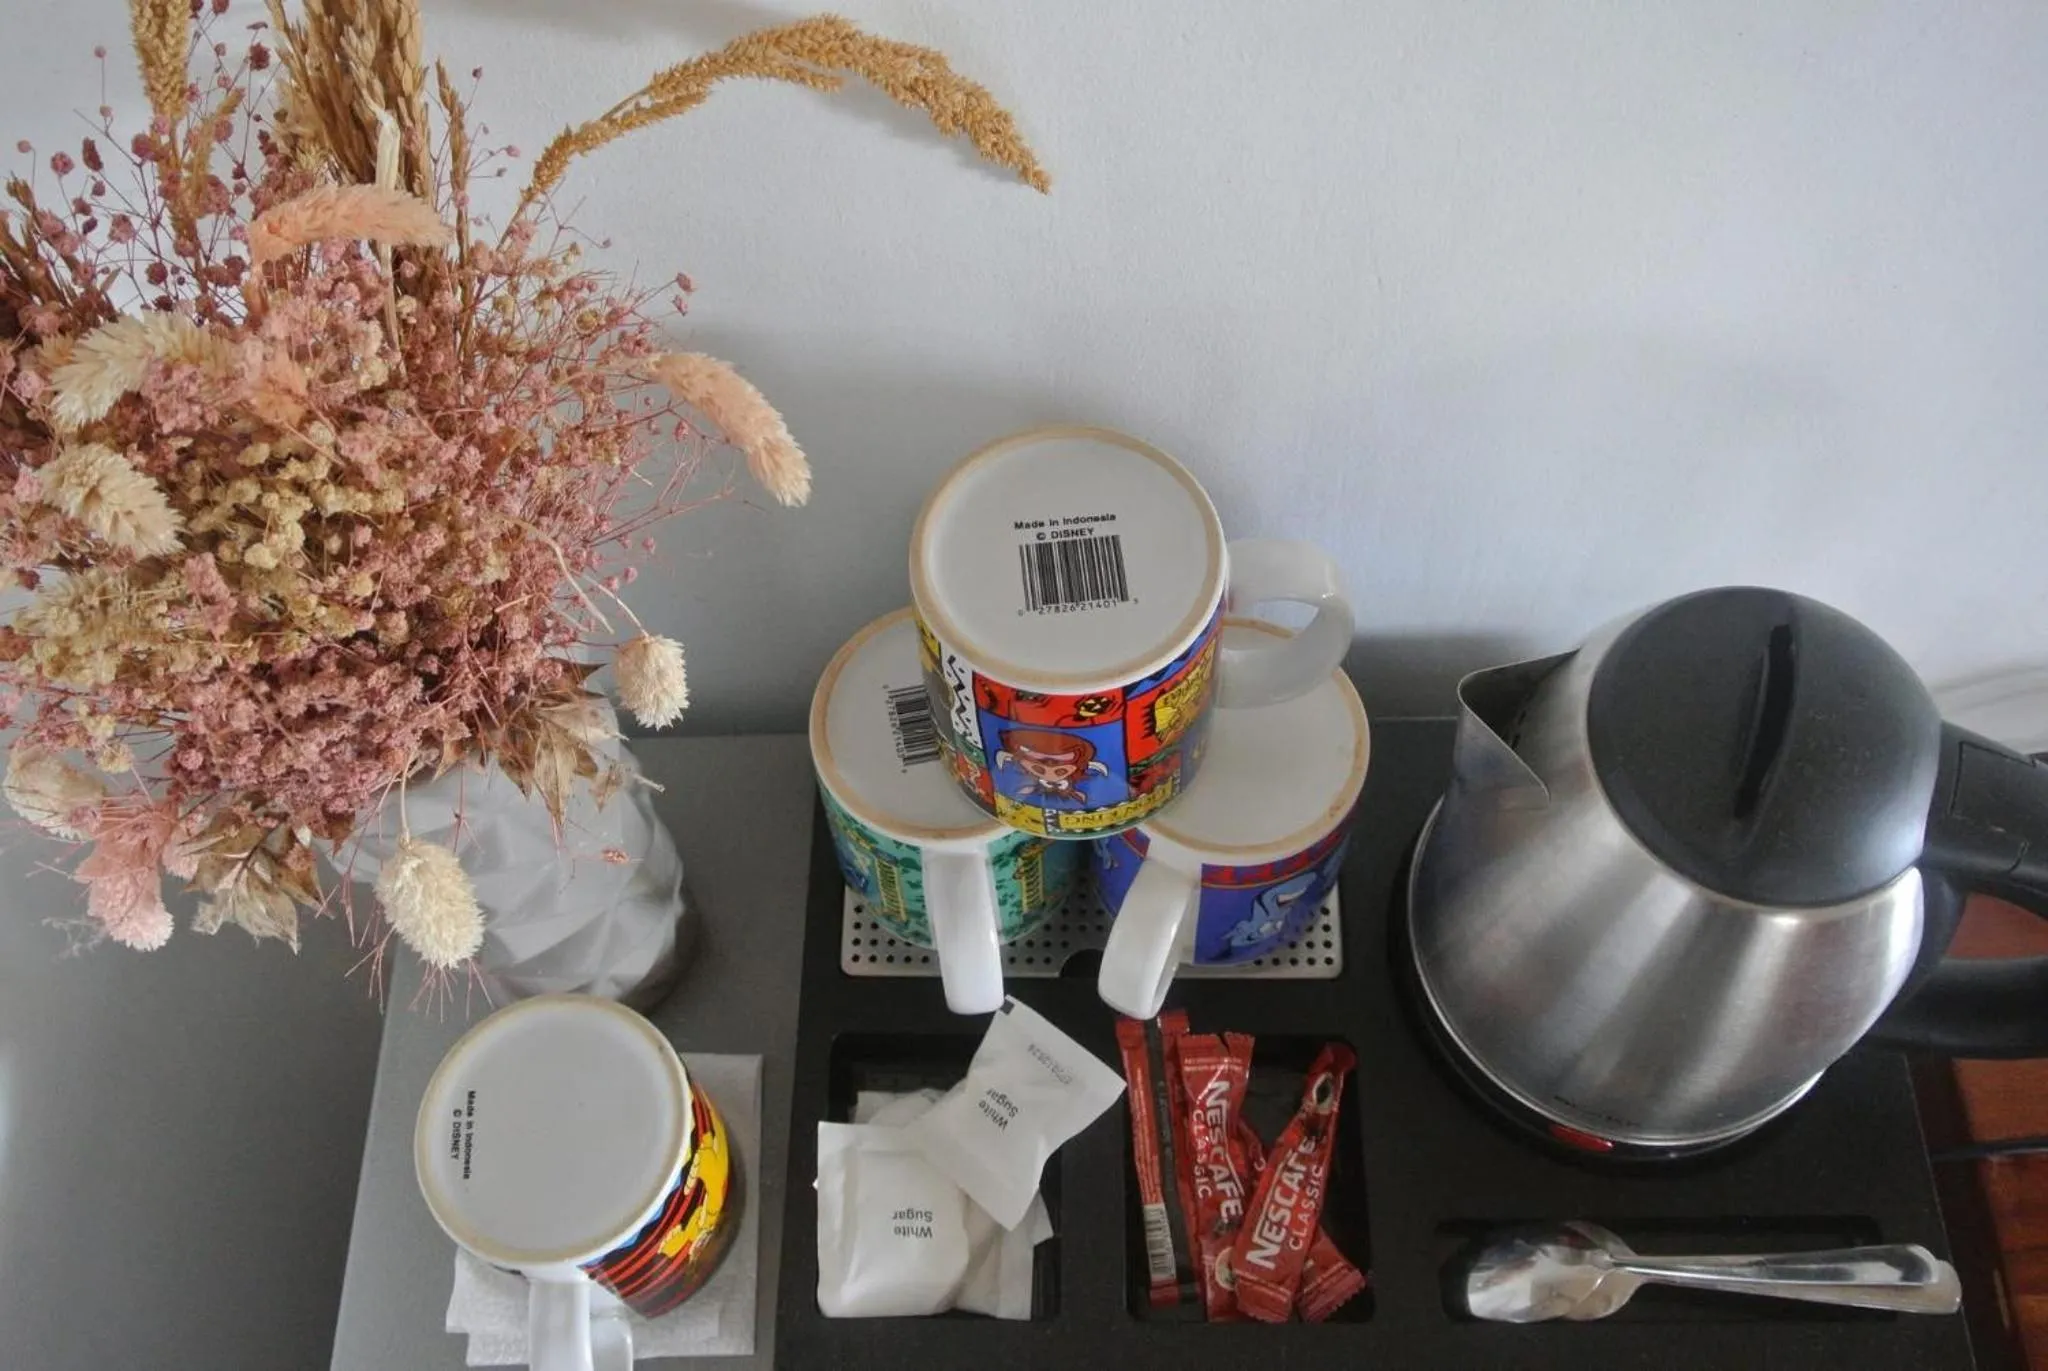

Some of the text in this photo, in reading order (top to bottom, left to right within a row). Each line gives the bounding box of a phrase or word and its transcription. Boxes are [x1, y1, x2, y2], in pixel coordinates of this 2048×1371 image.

[1014, 513, 1117, 530] Made in Indonesia
[1051, 528, 1095, 540] DISNEY
[466, 1090, 476, 1117] Made
[979, 1100, 1008, 1131] White
[986, 1089, 1019, 1119] Sugar
[451, 1121, 461, 1160] DISNEY
[463, 1133, 473, 1180] Indonesia
[892, 1207, 934, 1223] Sugar
[1289, 1164, 1324, 1251] CLASSIC
[894, 1225, 933, 1240] White
